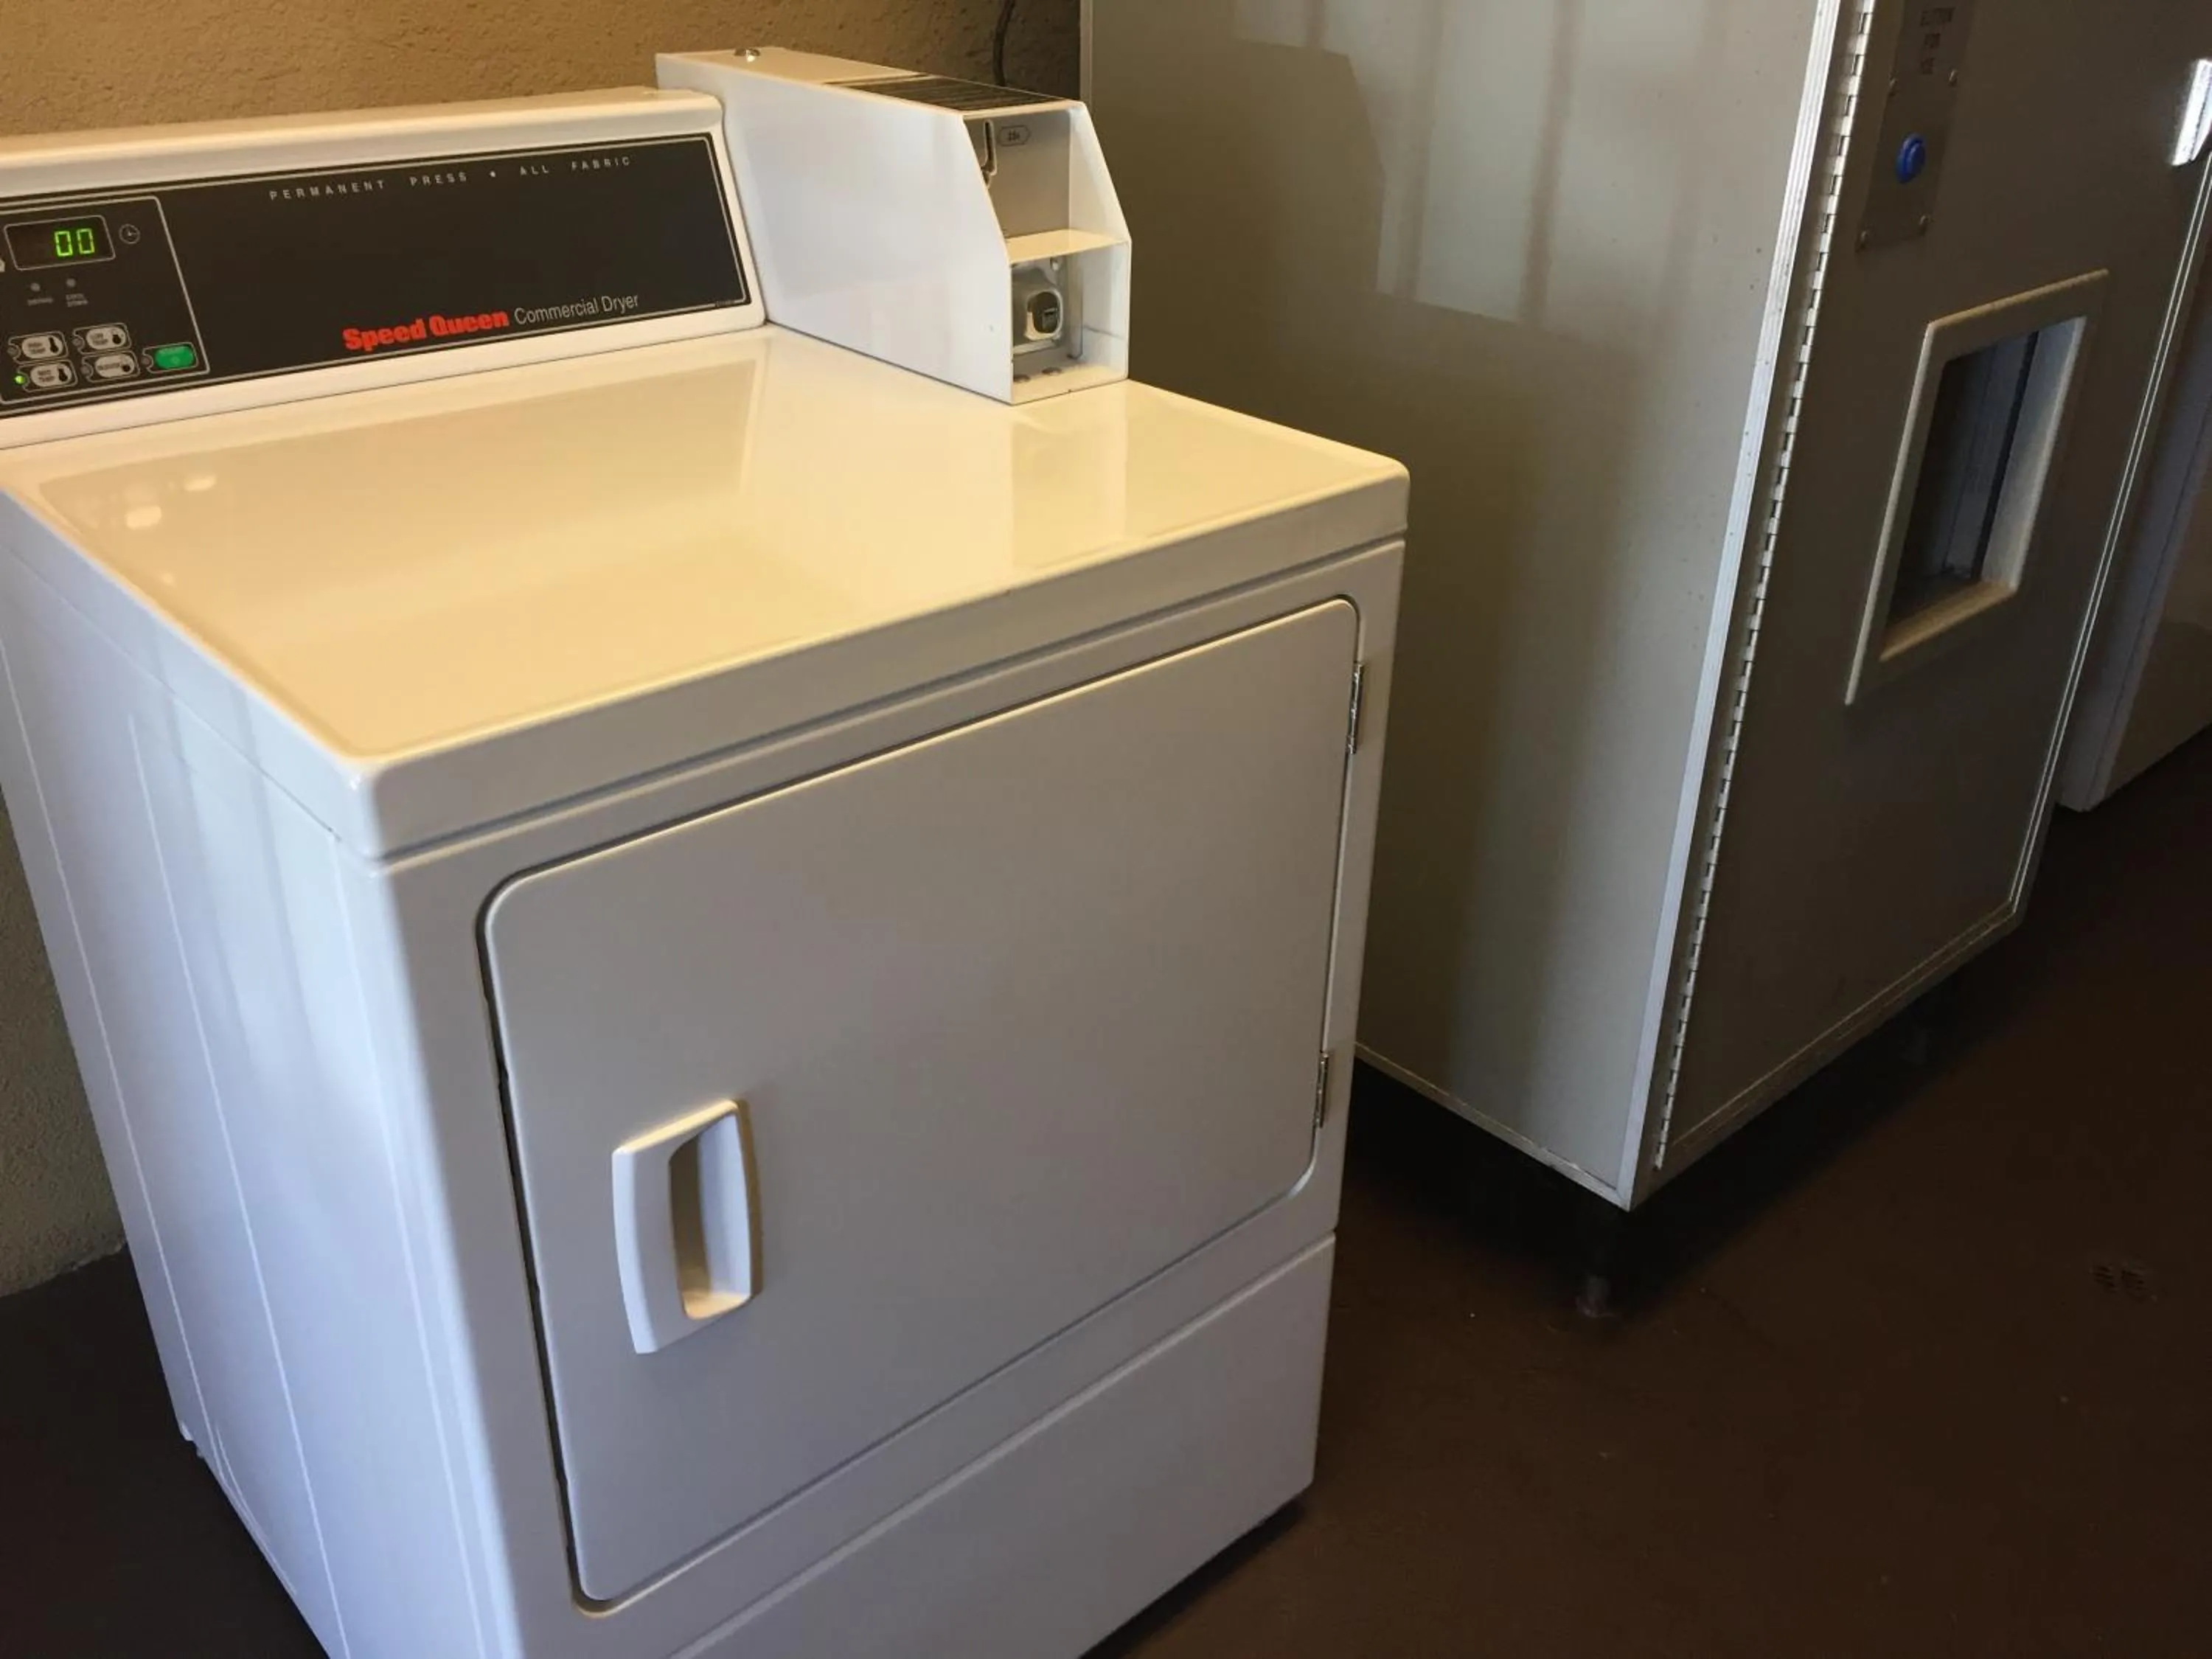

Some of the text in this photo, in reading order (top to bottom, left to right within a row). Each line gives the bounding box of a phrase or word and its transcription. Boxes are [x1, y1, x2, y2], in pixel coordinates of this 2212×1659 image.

[270, 156, 630, 200] PERMANENT PRESS ALL FABRIC
[54, 228, 95, 257] 00
[343, 293, 639, 351] Speed Queen Commercial Dryer
